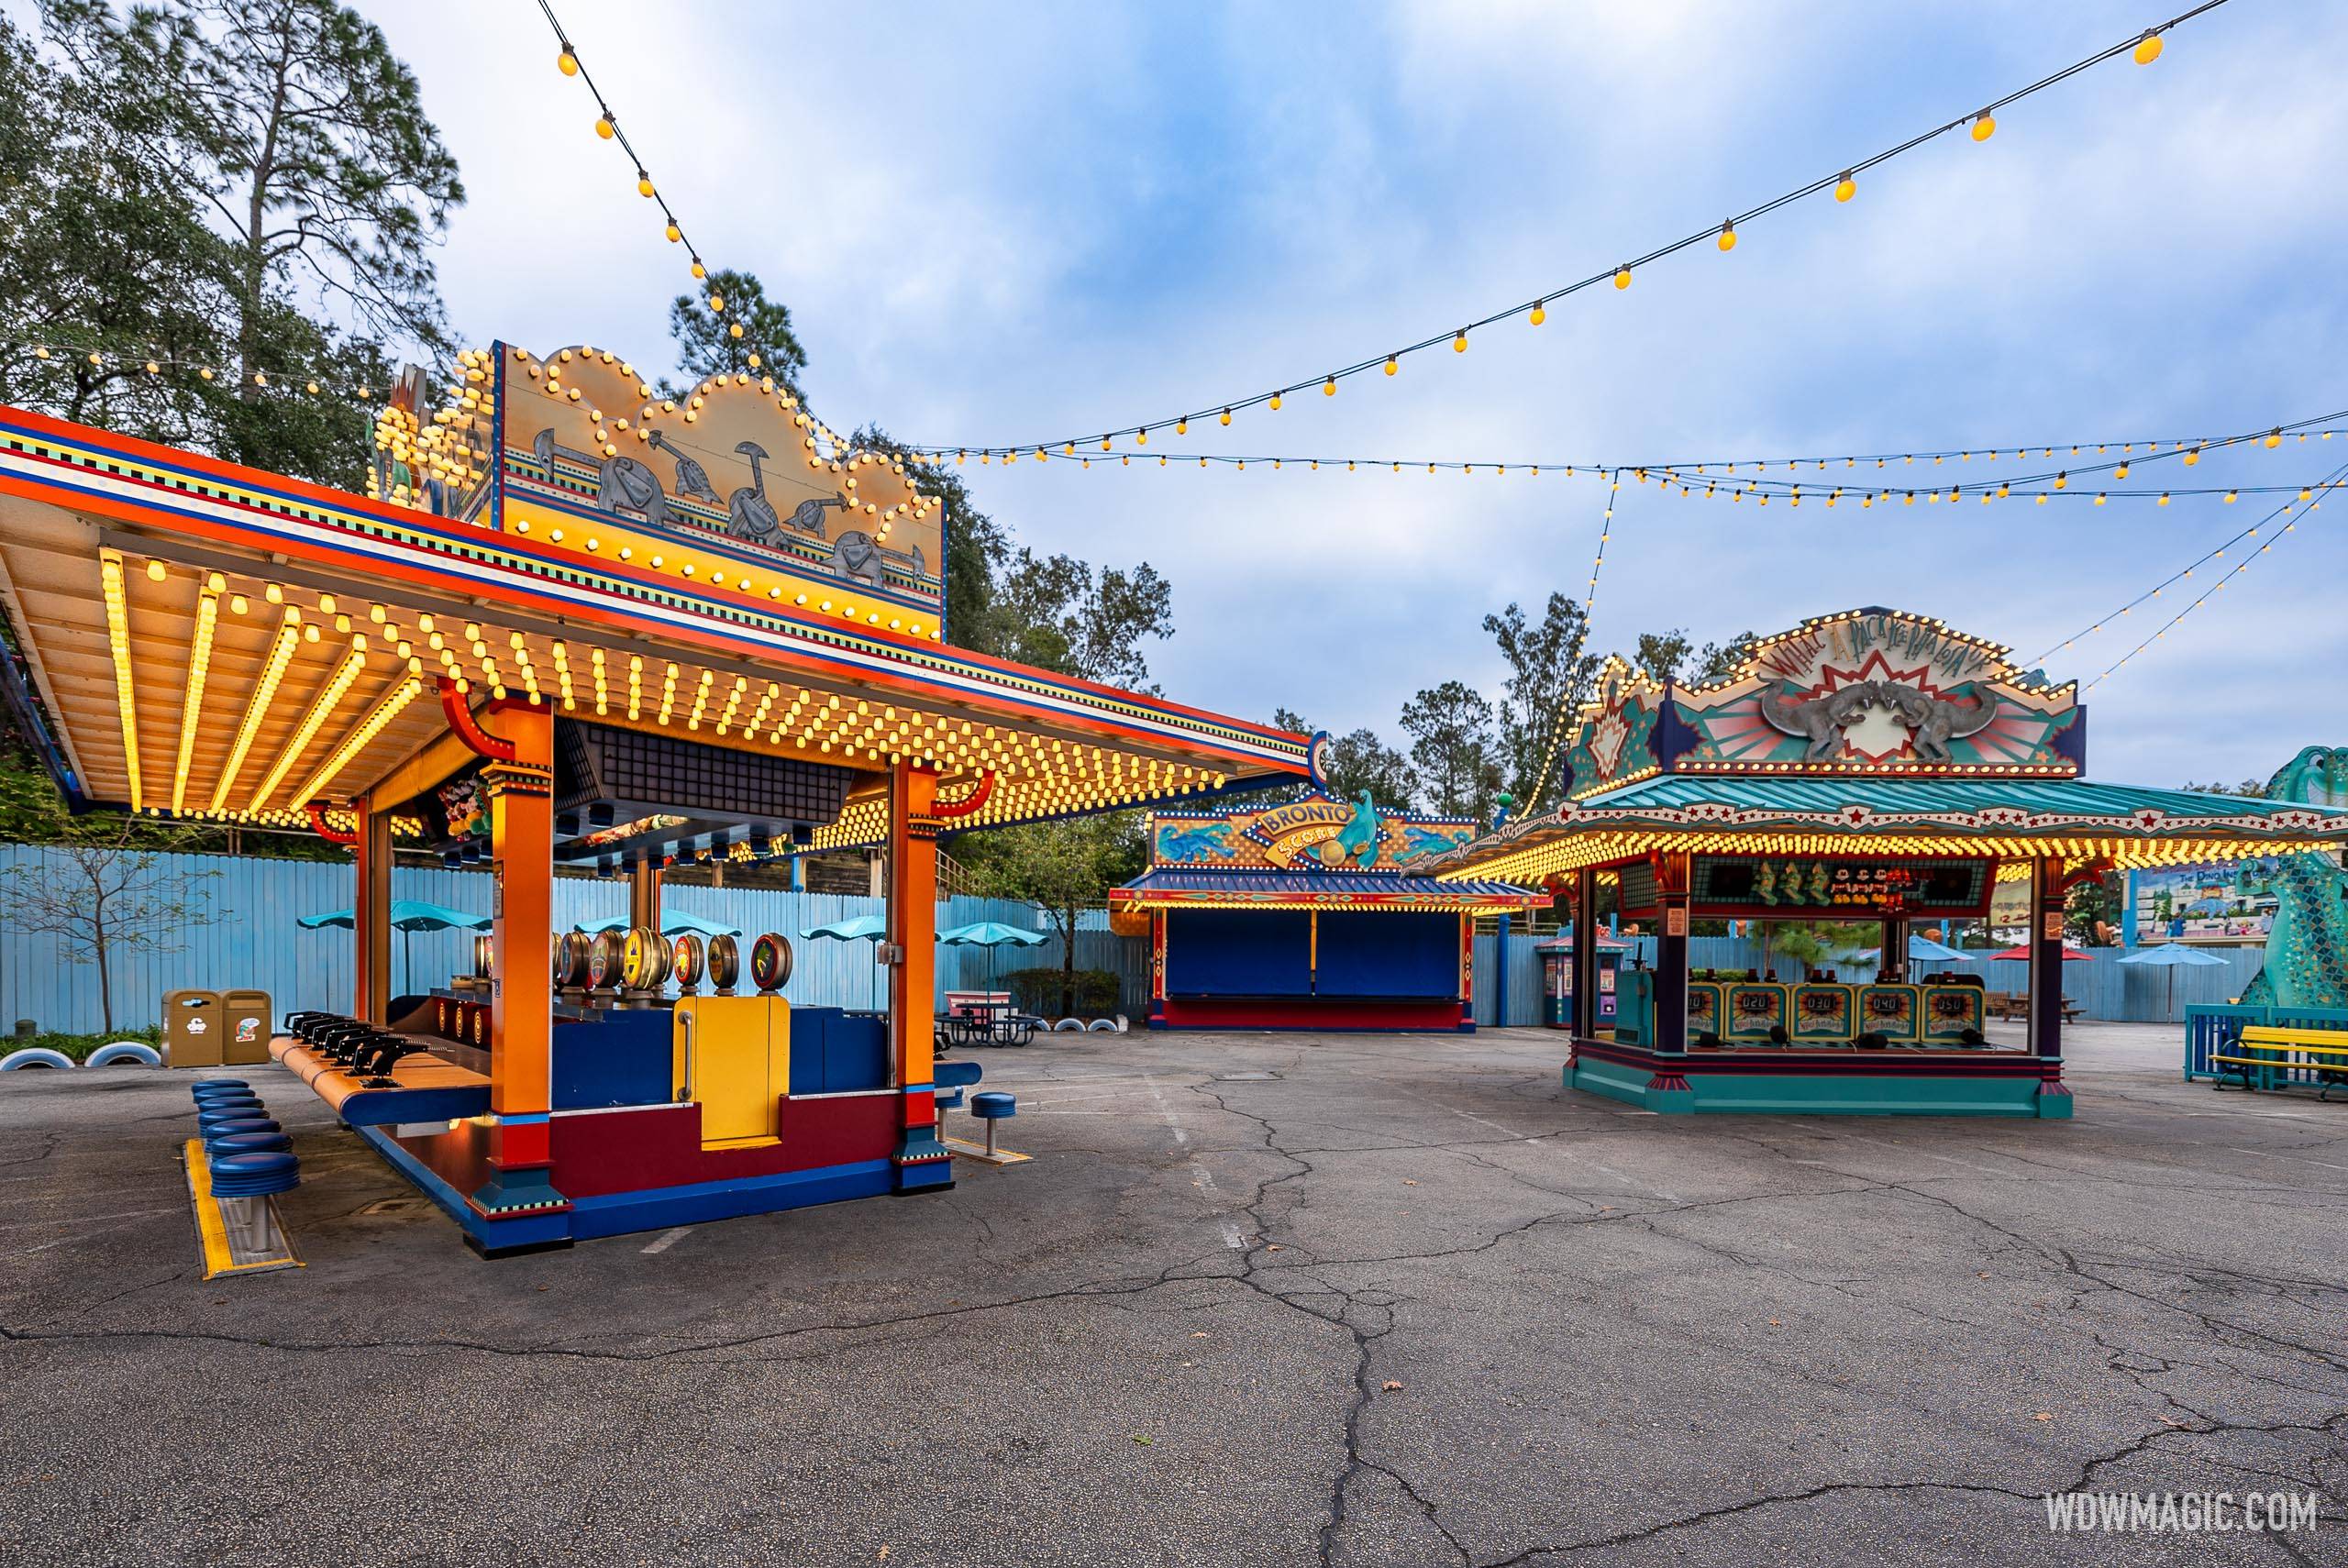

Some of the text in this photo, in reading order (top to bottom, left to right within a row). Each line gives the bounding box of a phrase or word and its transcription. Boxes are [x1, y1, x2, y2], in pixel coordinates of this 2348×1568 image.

[1759, 627, 1826, 678] WHAT
[1831, 624, 1852, 660] A
[1263, 805, 1351, 832] BRONTO
[1278, 826, 1337, 859] SCORE
[2197, 870, 2221, 881] DINO
[1743, 997, 1766, 1008] 020
[1808, 997, 1831, 1008] 030
[1873, 998, 1896, 1009] 040
